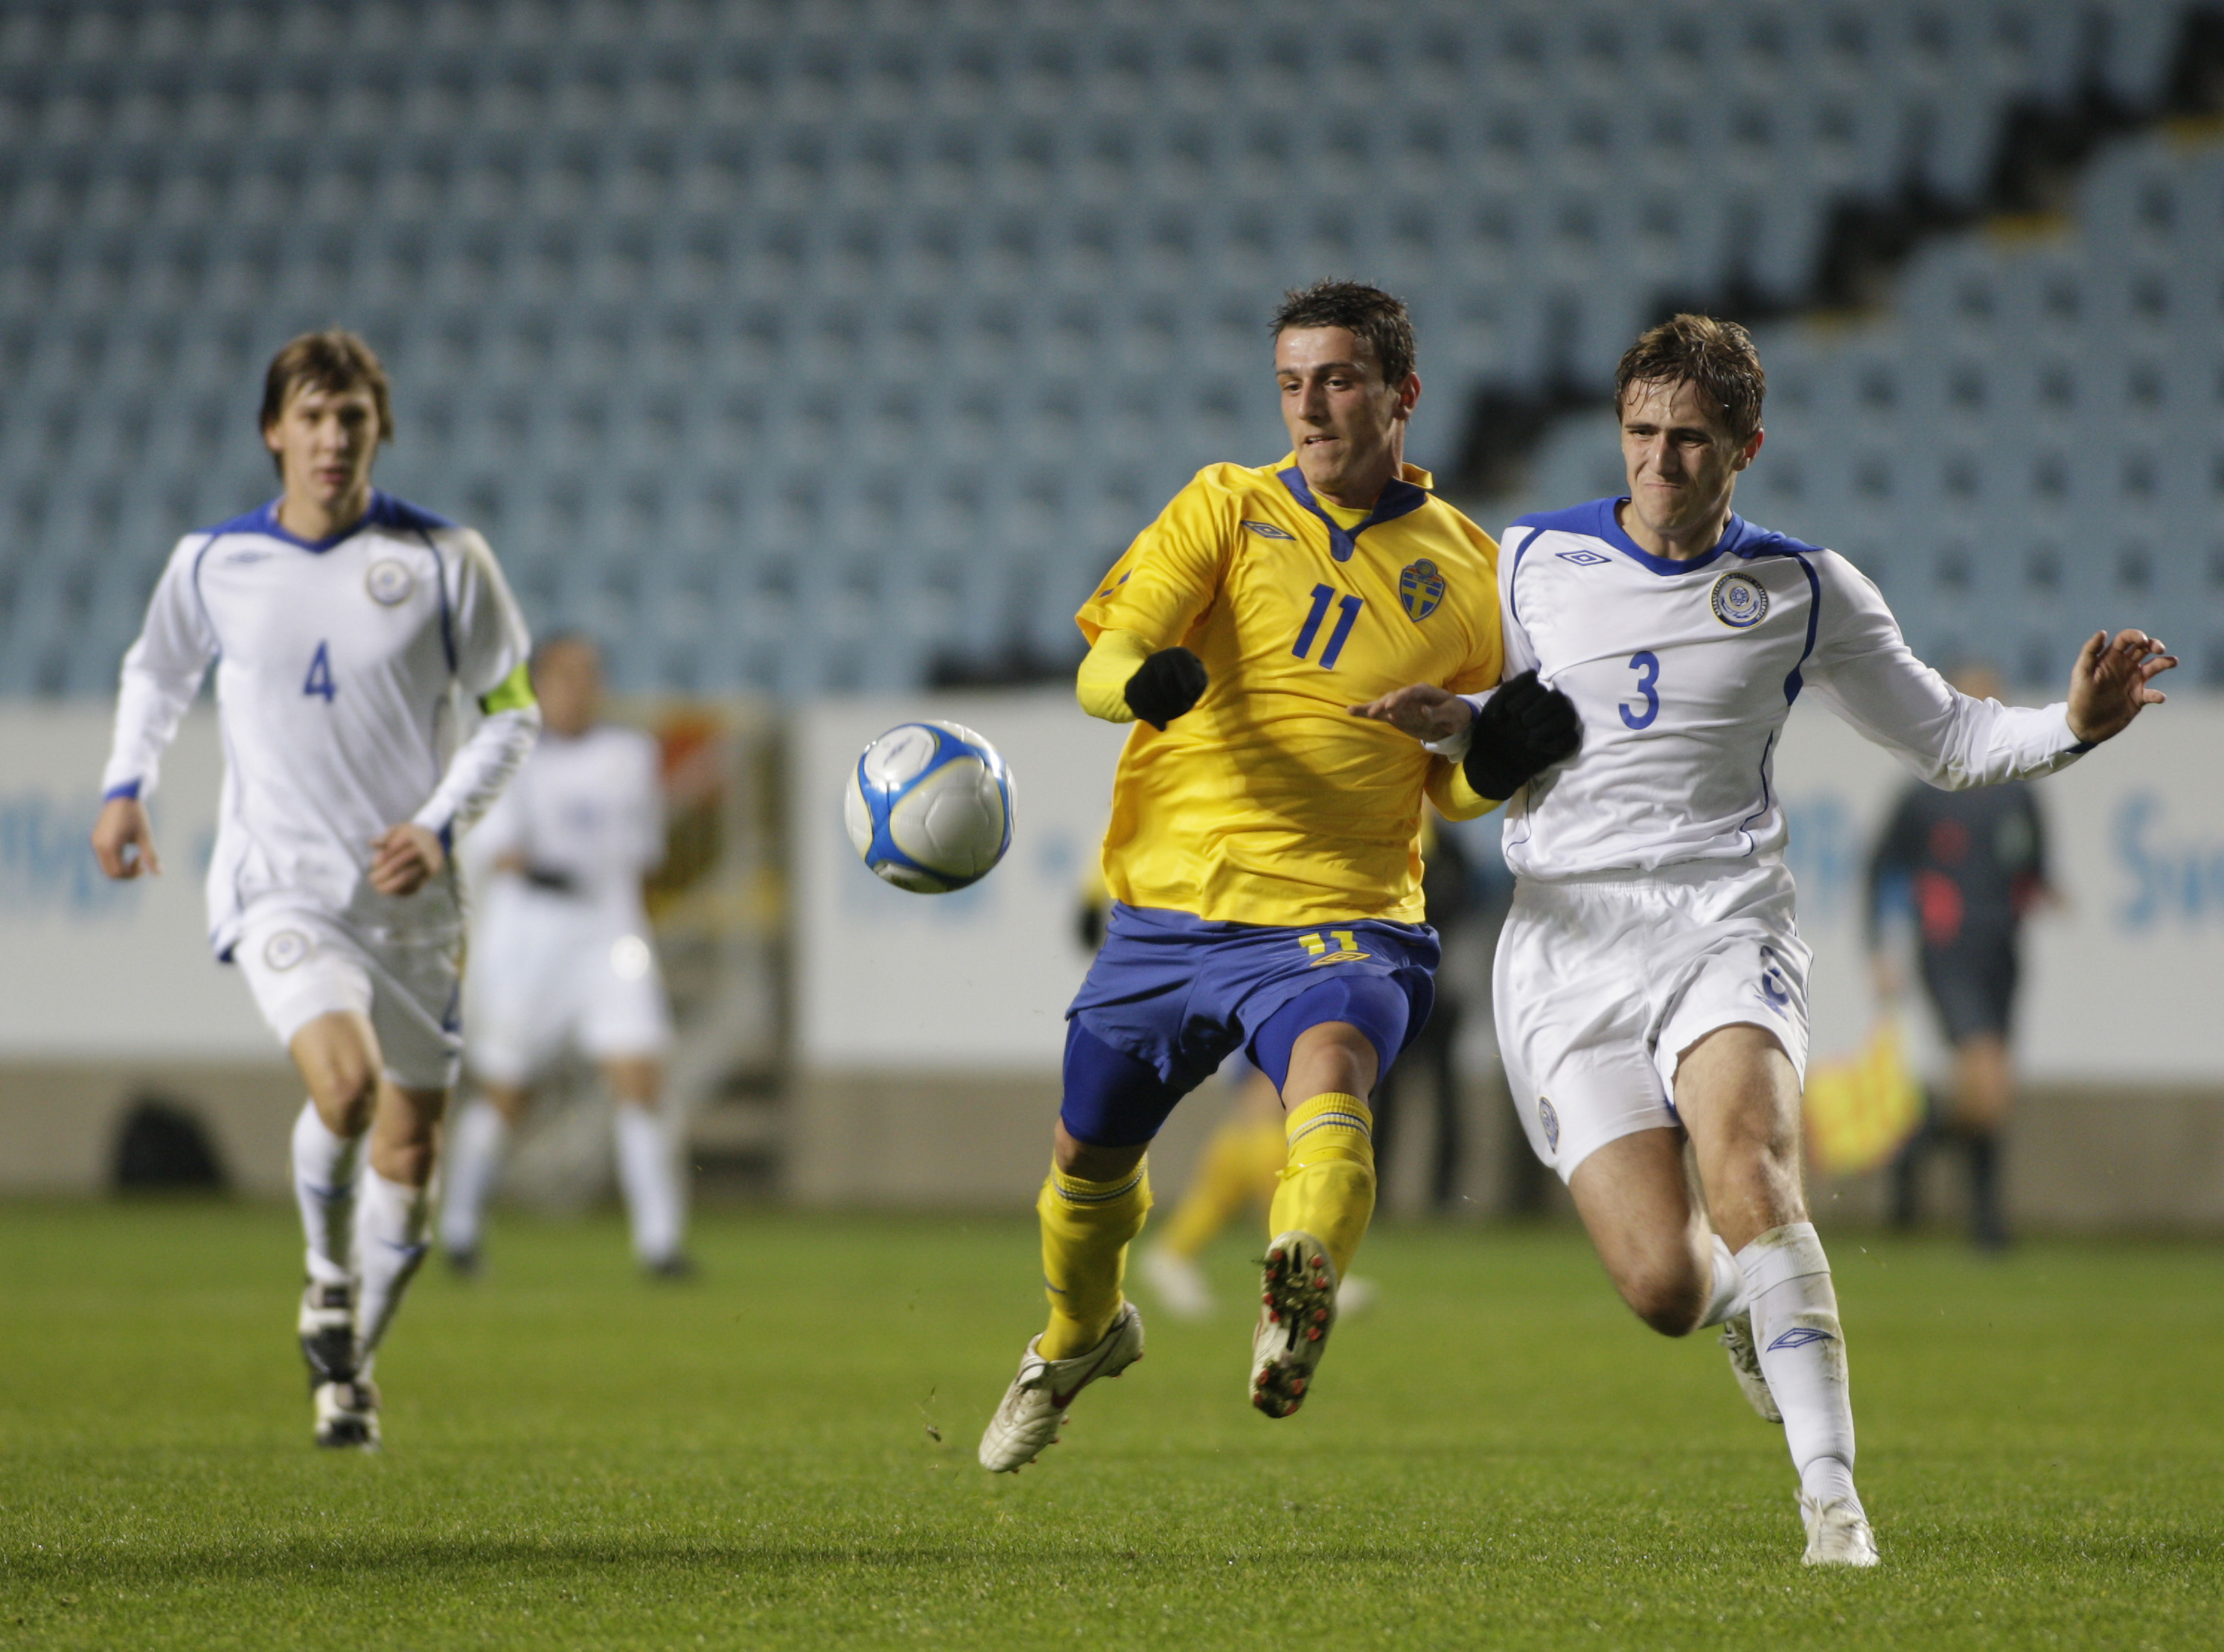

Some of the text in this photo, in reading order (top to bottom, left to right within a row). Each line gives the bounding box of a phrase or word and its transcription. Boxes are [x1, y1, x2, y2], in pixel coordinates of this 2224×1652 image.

[1291, 583, 1364, 670] 11
[304, 639, 336, 702] 4
[1619, 650, 1659, 729] 3
